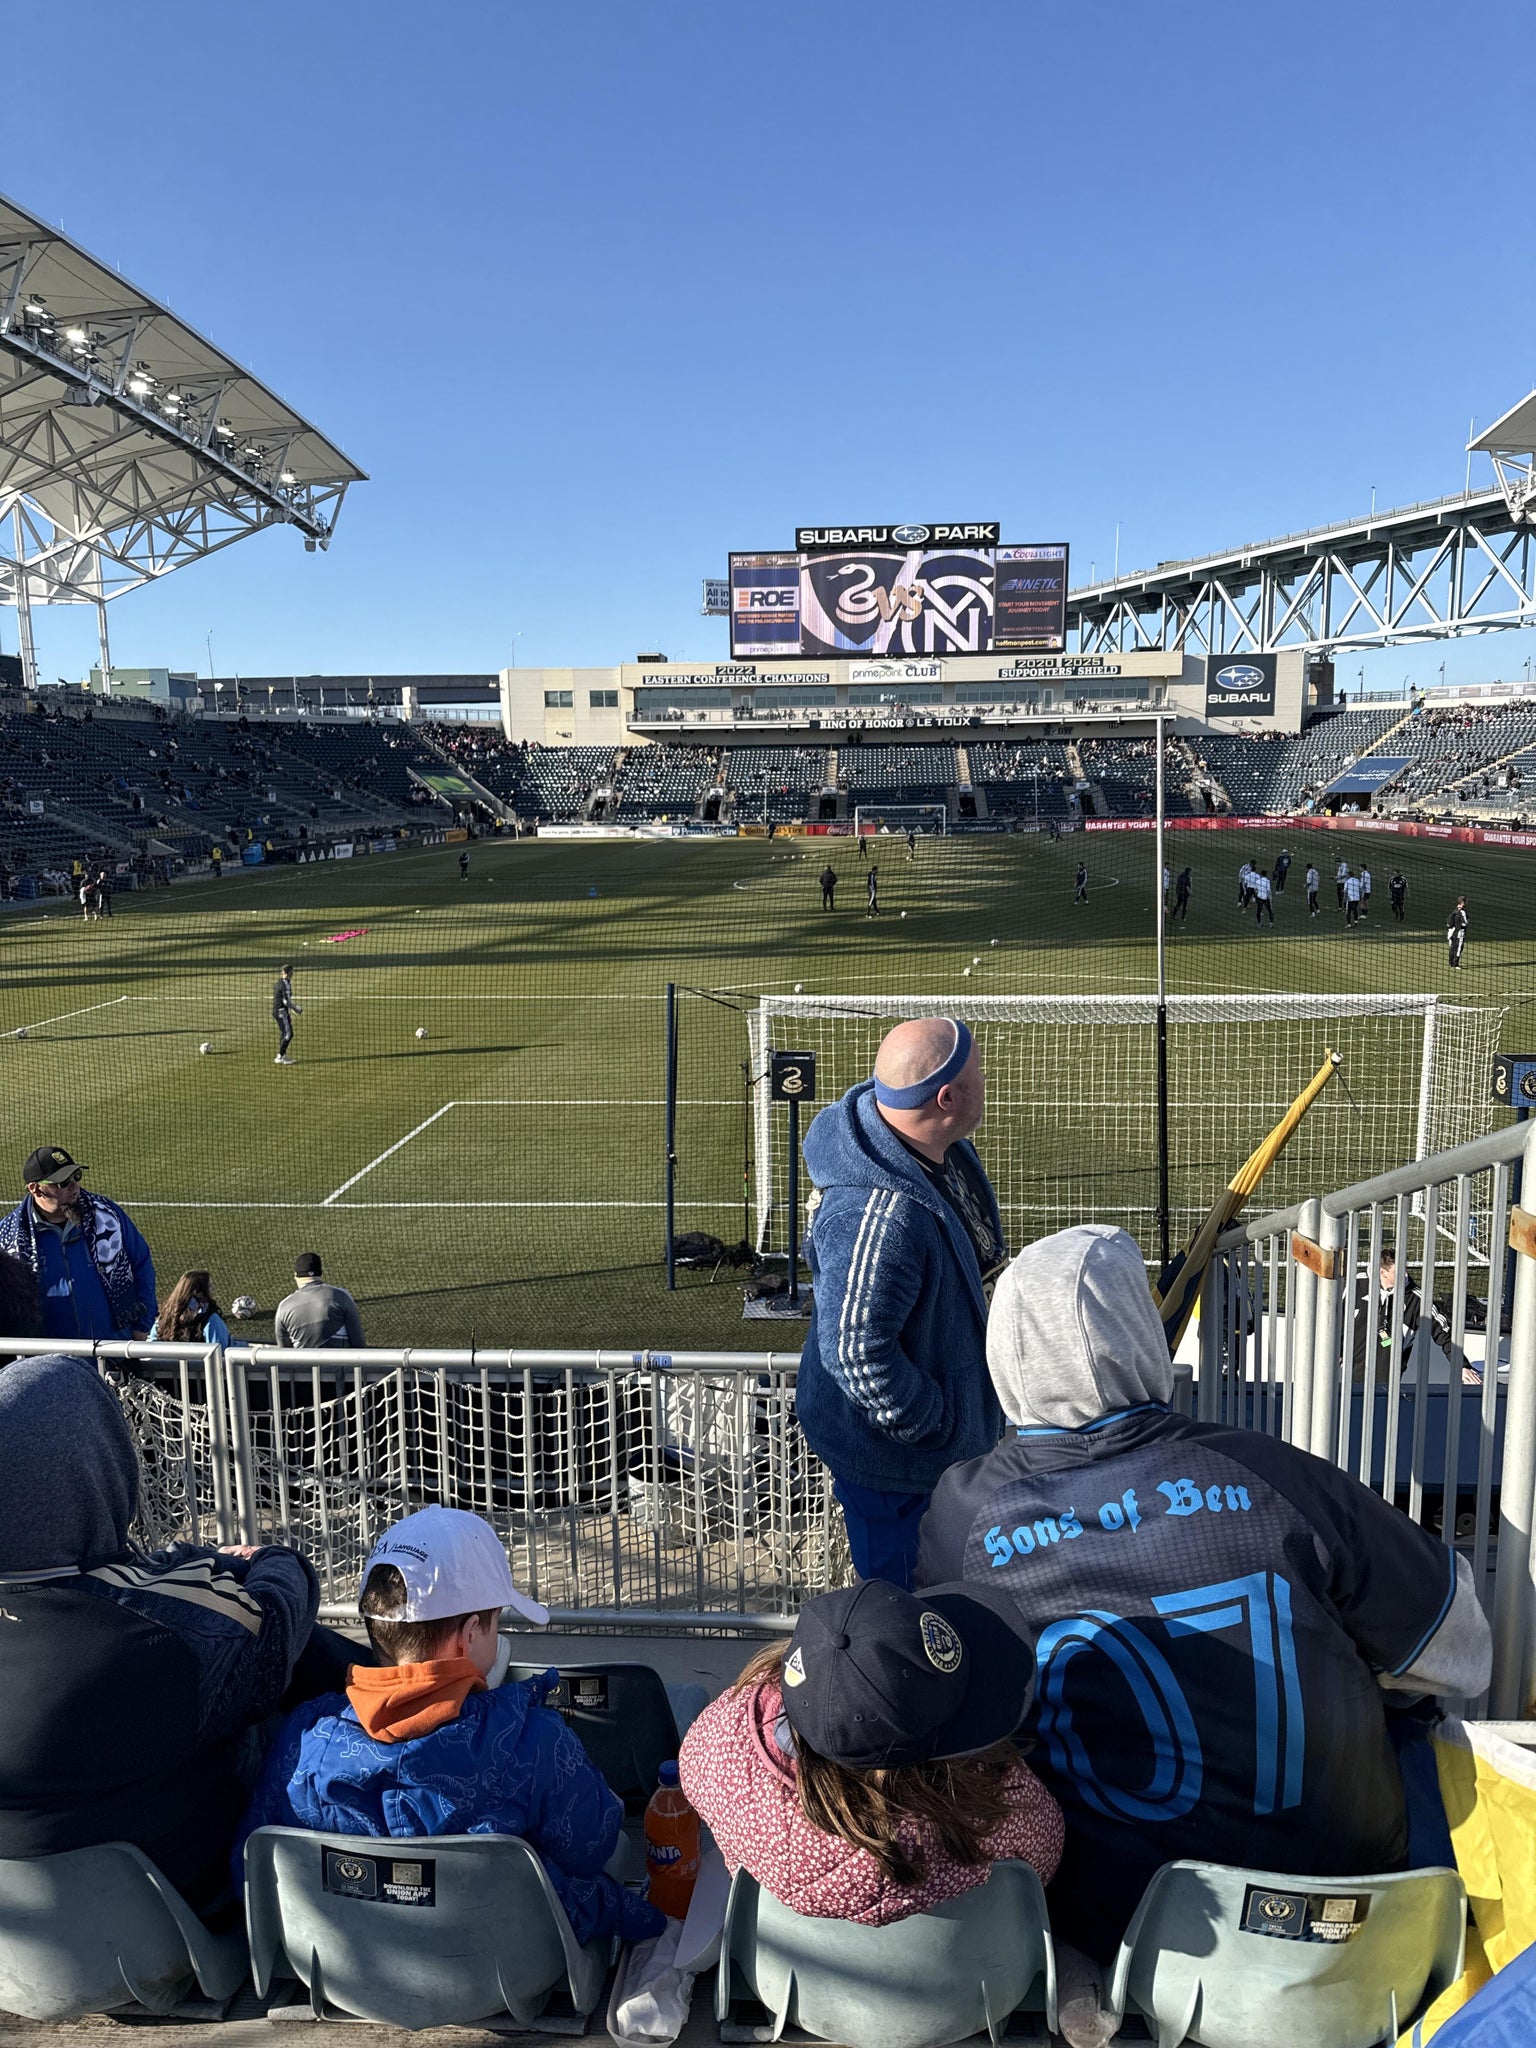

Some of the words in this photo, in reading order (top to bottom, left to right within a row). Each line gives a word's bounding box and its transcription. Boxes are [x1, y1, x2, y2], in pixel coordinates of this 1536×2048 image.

[800, 527, 888, 544] SUBARU
[934, 525, 995, 541] PARK
[1013, 549, 1038, 559] Coors
[1014, 577, 1061, 590] KINETIC
[706, 588, 718, 597] All
[706, 597, 718, 606] All
[1017, 660, 1056, 668] 2020
[717, 666, 754, 675] 2022
[852, 669, 902, 680] primepoint
[905, 668, 937, 677] CLUB
[1001, 667, 1076, 678] SUPPORTERS'
[1077, 666, 1118, 676] SHIELD
[644, 675, 692, 685] EASTERN
[693, 675, 763, 684] CONFERENCE
[764, 673, 829, 684] CHAMPIONS
[1208, 693, 1271, 703] SUBARU
[819, 720, 848, 729] RING
[849, 720, 863, 728] OF
[865, 719, 904, 728] HONOR
[917, 718, 932, 726] LE
[935, 717, 971, 726] TOUX
[1151, 821, 1173, 829] SOT
[681, 827, 700, 837] Penn
[1484, 832, 1511, 844] GUARANTEE
[1512, 835, 1526, 845] YOUR
[983, 1505, 1084, 1568] Sons
[1097, 1487, 1143, 1534] of
[1155, 1477, 1252, 1517] Ben
[394, 1543, 429, 1560] LANGUAGE
[383, 1883, 418, 1892] DOWNLOAD
[387, 1889, 412, 1897] UNION
[1310, 1921, 1348, 1929] DOWNLOAD
[1312, 1927, 1341, 1935] UNION
[1341, 1927, 1358, 1935] APP
